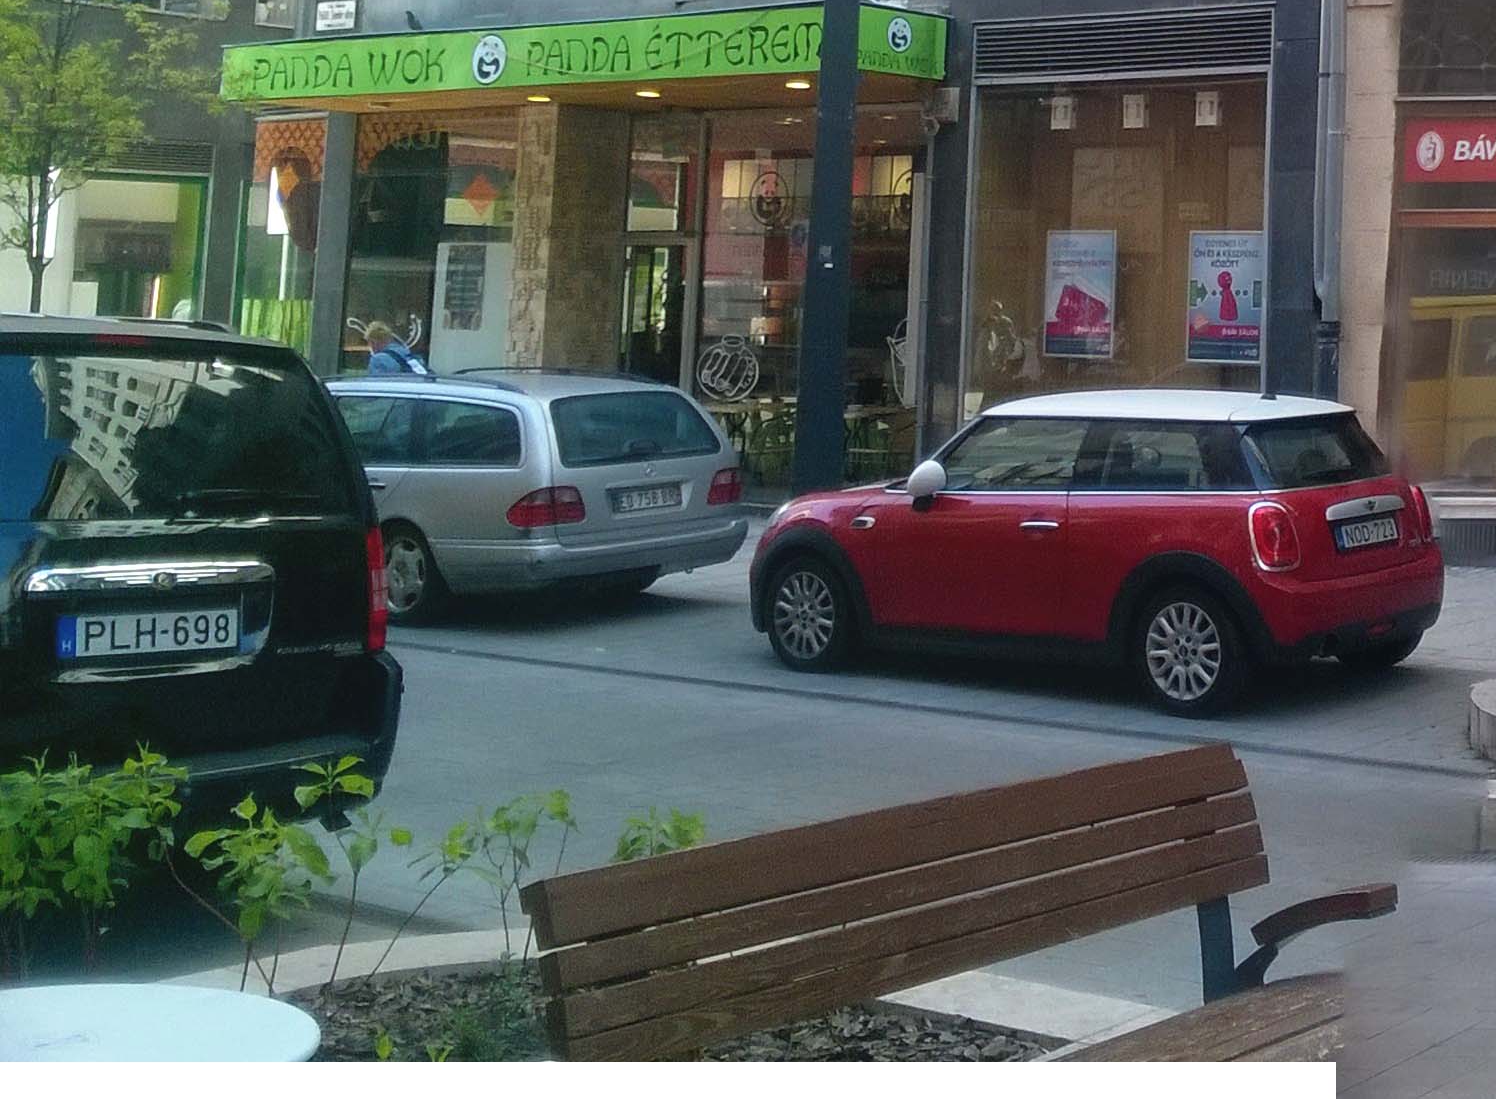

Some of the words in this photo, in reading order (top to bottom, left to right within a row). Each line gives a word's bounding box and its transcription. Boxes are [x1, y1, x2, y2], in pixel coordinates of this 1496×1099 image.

[252, 52, 353, 91] PANDA
[368, 47, 448, 85] WOK
[527, 35, 631, 77] PANDA
[645, 23, 824, 70] ÉTTEREM
[84, 613, 230, 652] PLH-698
